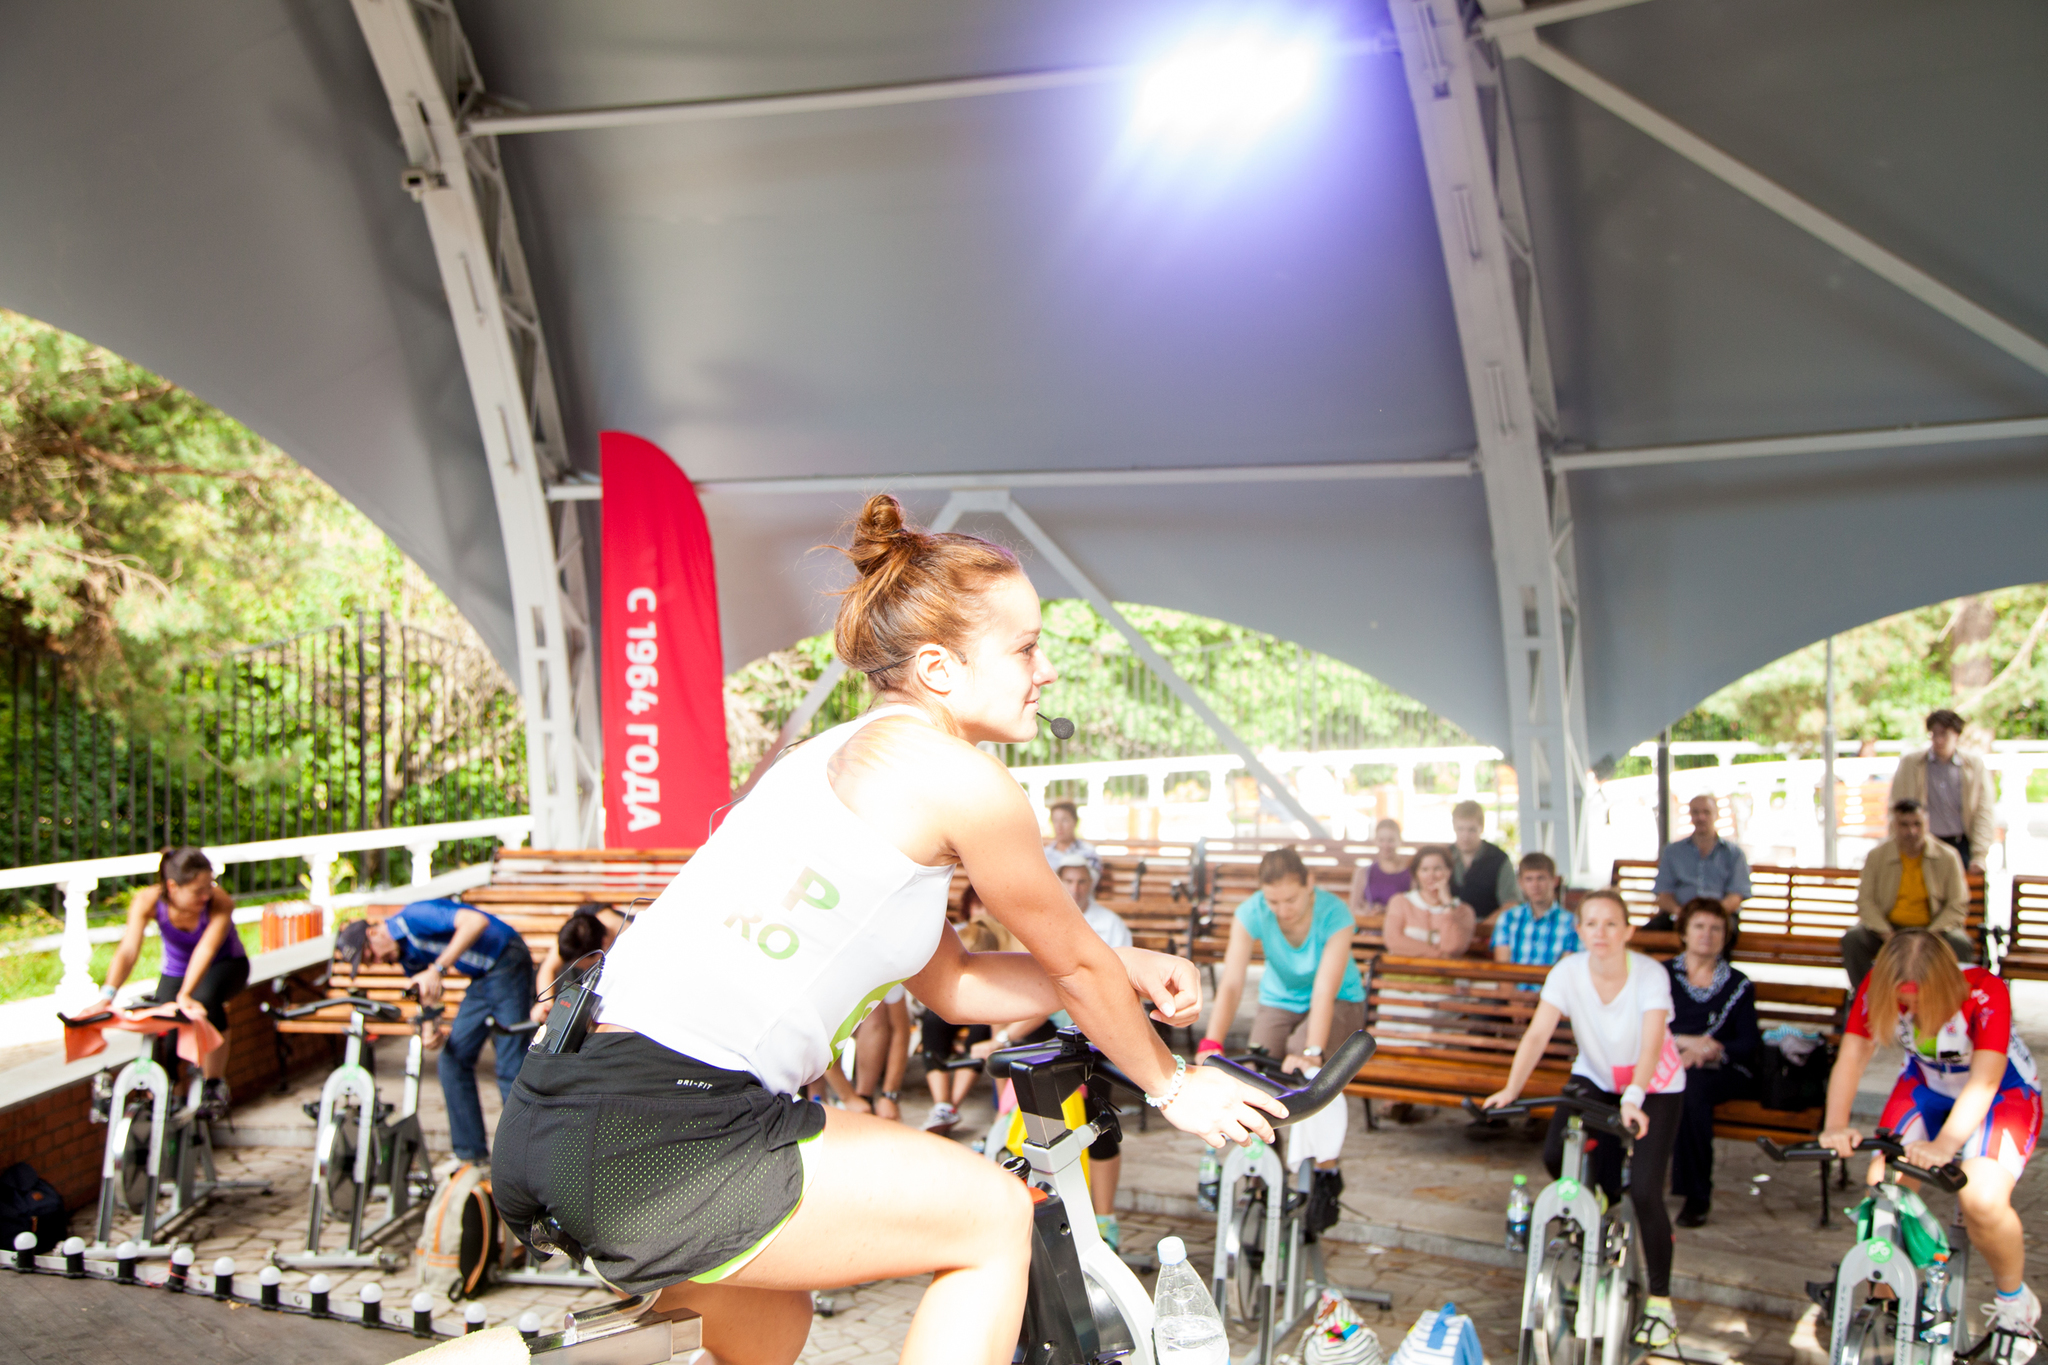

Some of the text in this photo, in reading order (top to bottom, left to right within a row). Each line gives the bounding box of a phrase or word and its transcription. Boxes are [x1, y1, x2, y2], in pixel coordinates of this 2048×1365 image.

[621, 587, 662, 833] С 1964 ГОДА
[676, 1079, 713, 1090] DRI-FIT
